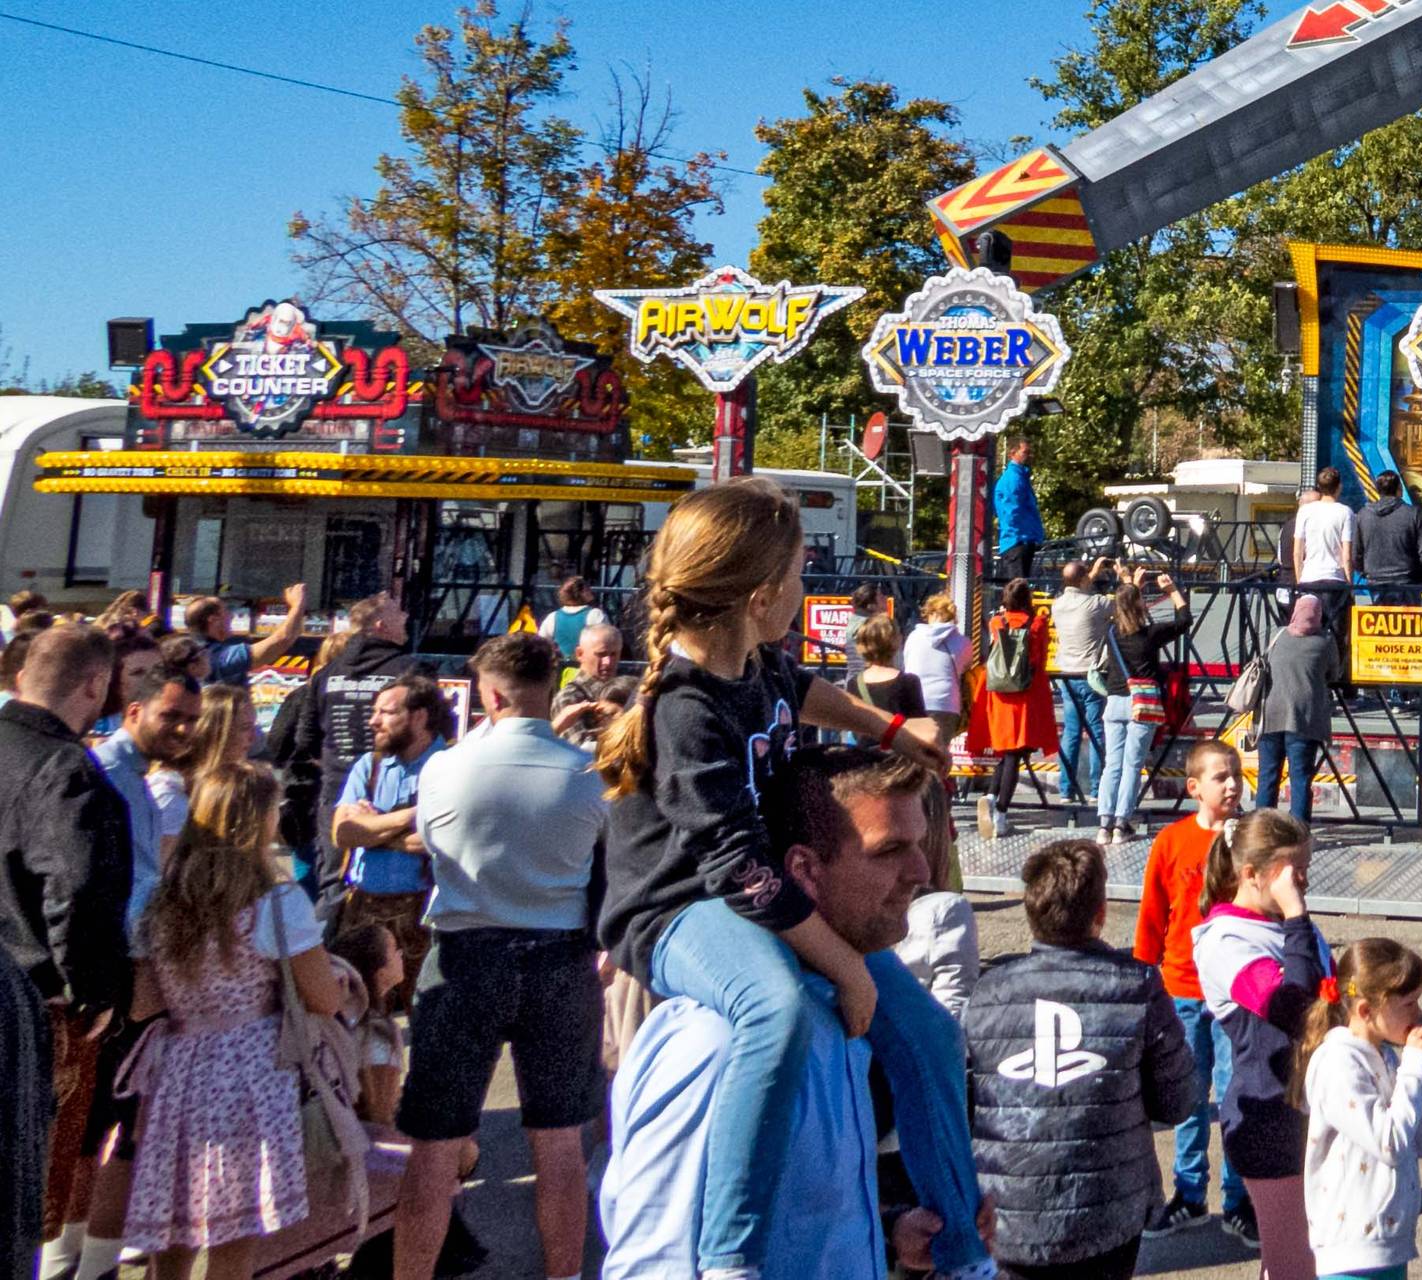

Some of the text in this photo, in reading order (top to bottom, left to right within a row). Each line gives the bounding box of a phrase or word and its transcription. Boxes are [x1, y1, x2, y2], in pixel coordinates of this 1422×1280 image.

[639, 297, 812, 345] AIRWOLF
[939, 315, 997, 330] THOMAS
[897, 328, 1034, 367] WEBER
[236, 354, 310, 376] TICKET
[918, 369, 1011, 378] SPACE FORCE
[212, 378, 329, 395] COUNTER
[1375, 645, 1405, 654] NOISE
